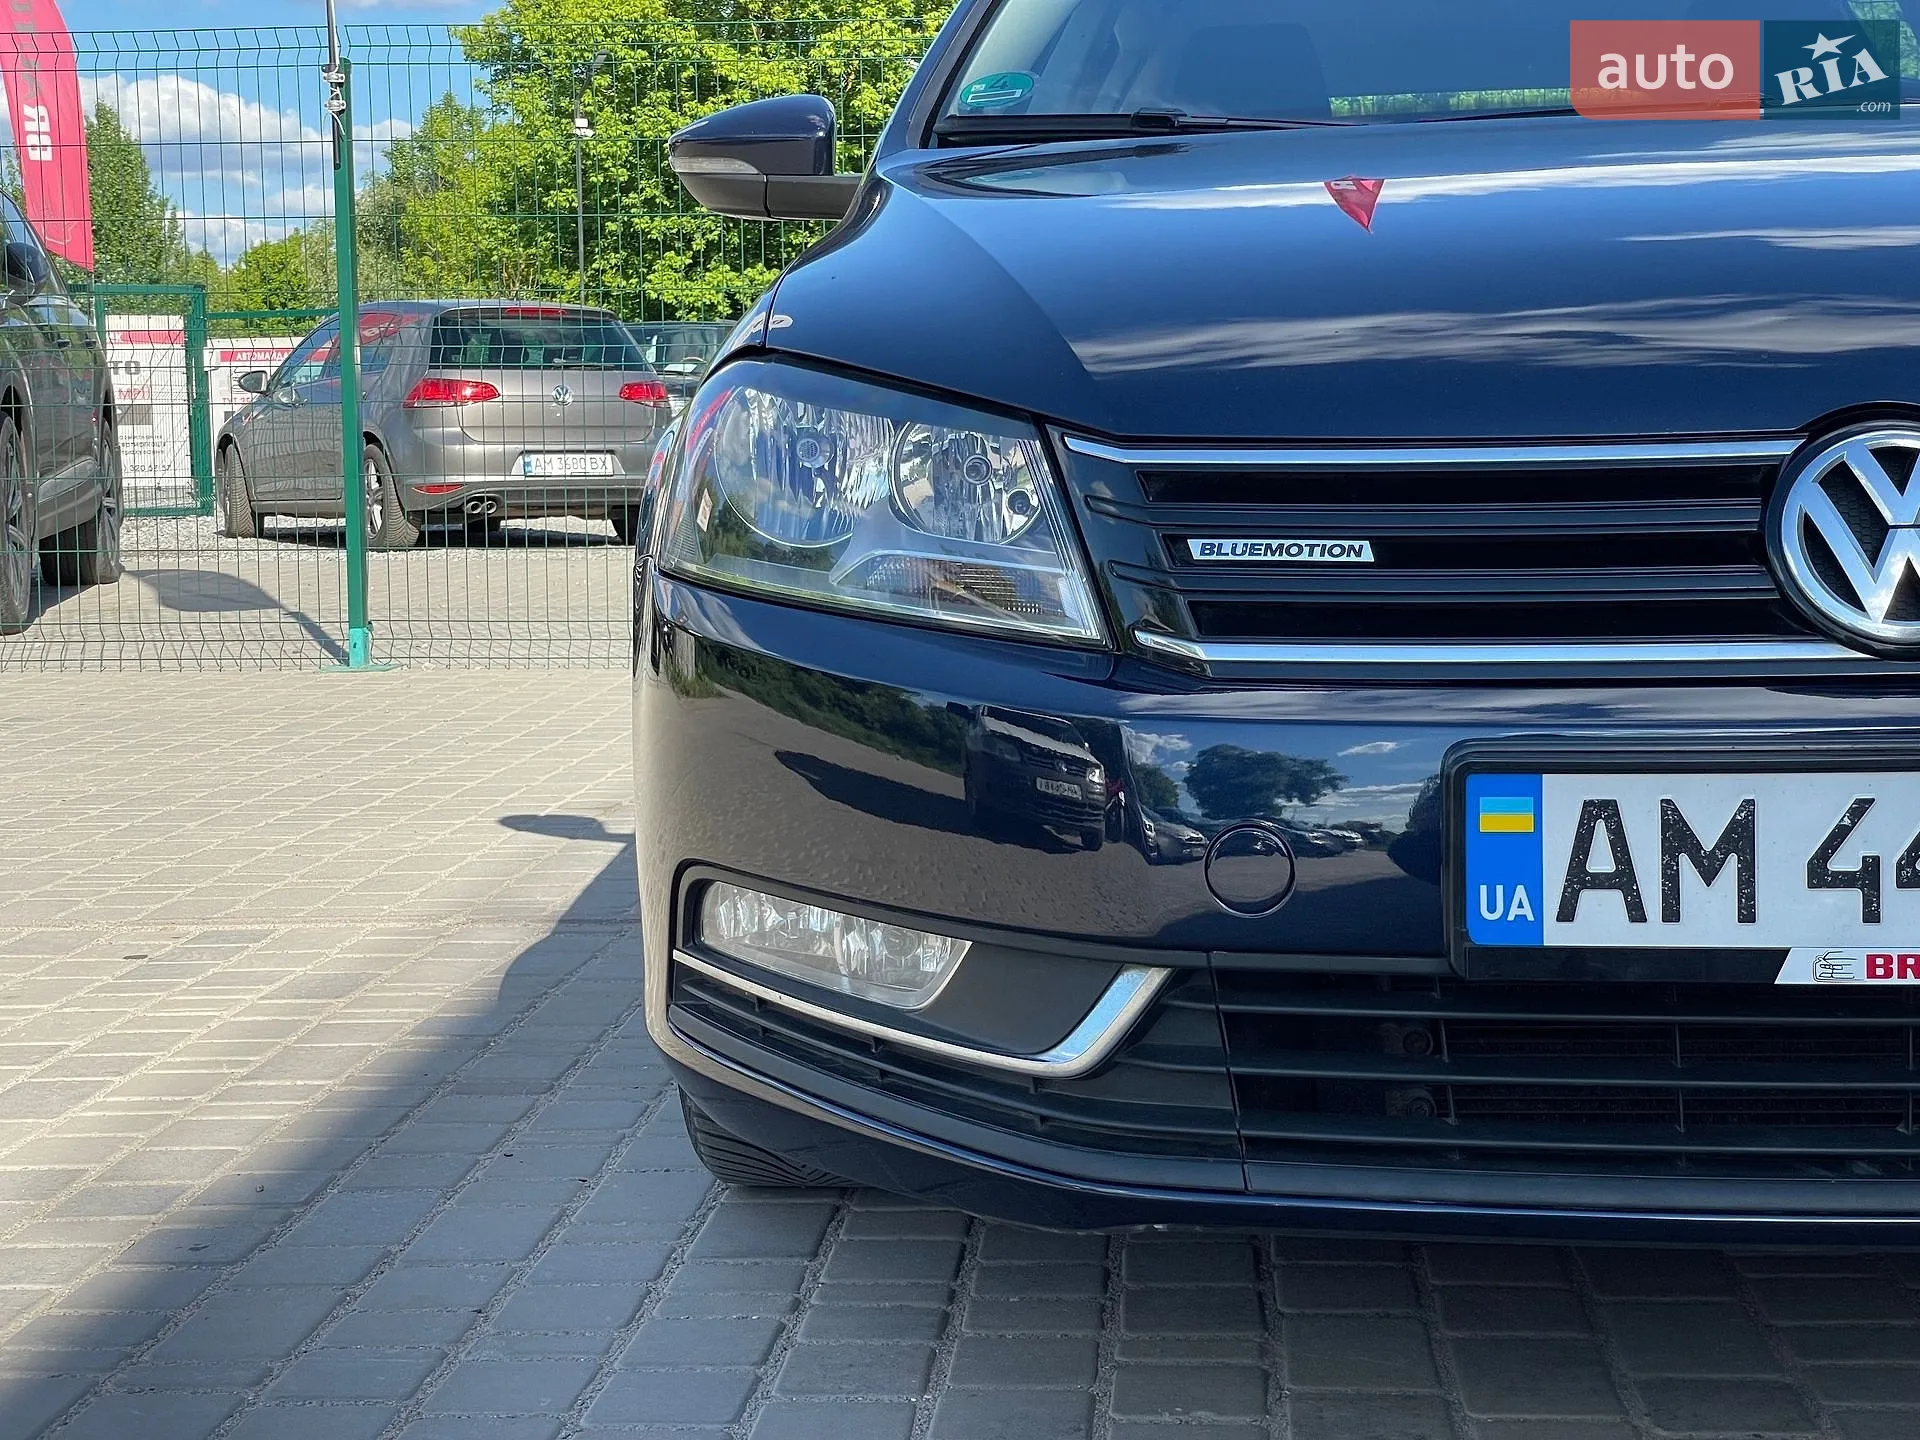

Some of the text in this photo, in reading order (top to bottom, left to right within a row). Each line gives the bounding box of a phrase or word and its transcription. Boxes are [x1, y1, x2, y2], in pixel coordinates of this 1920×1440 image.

[589, 457, 608, 470] BX
[1200, 542, 1364, 558] BLUEMOTION
[1555, 797, 1757, 924] AM
[1479, 884, 1535, 921] UA
